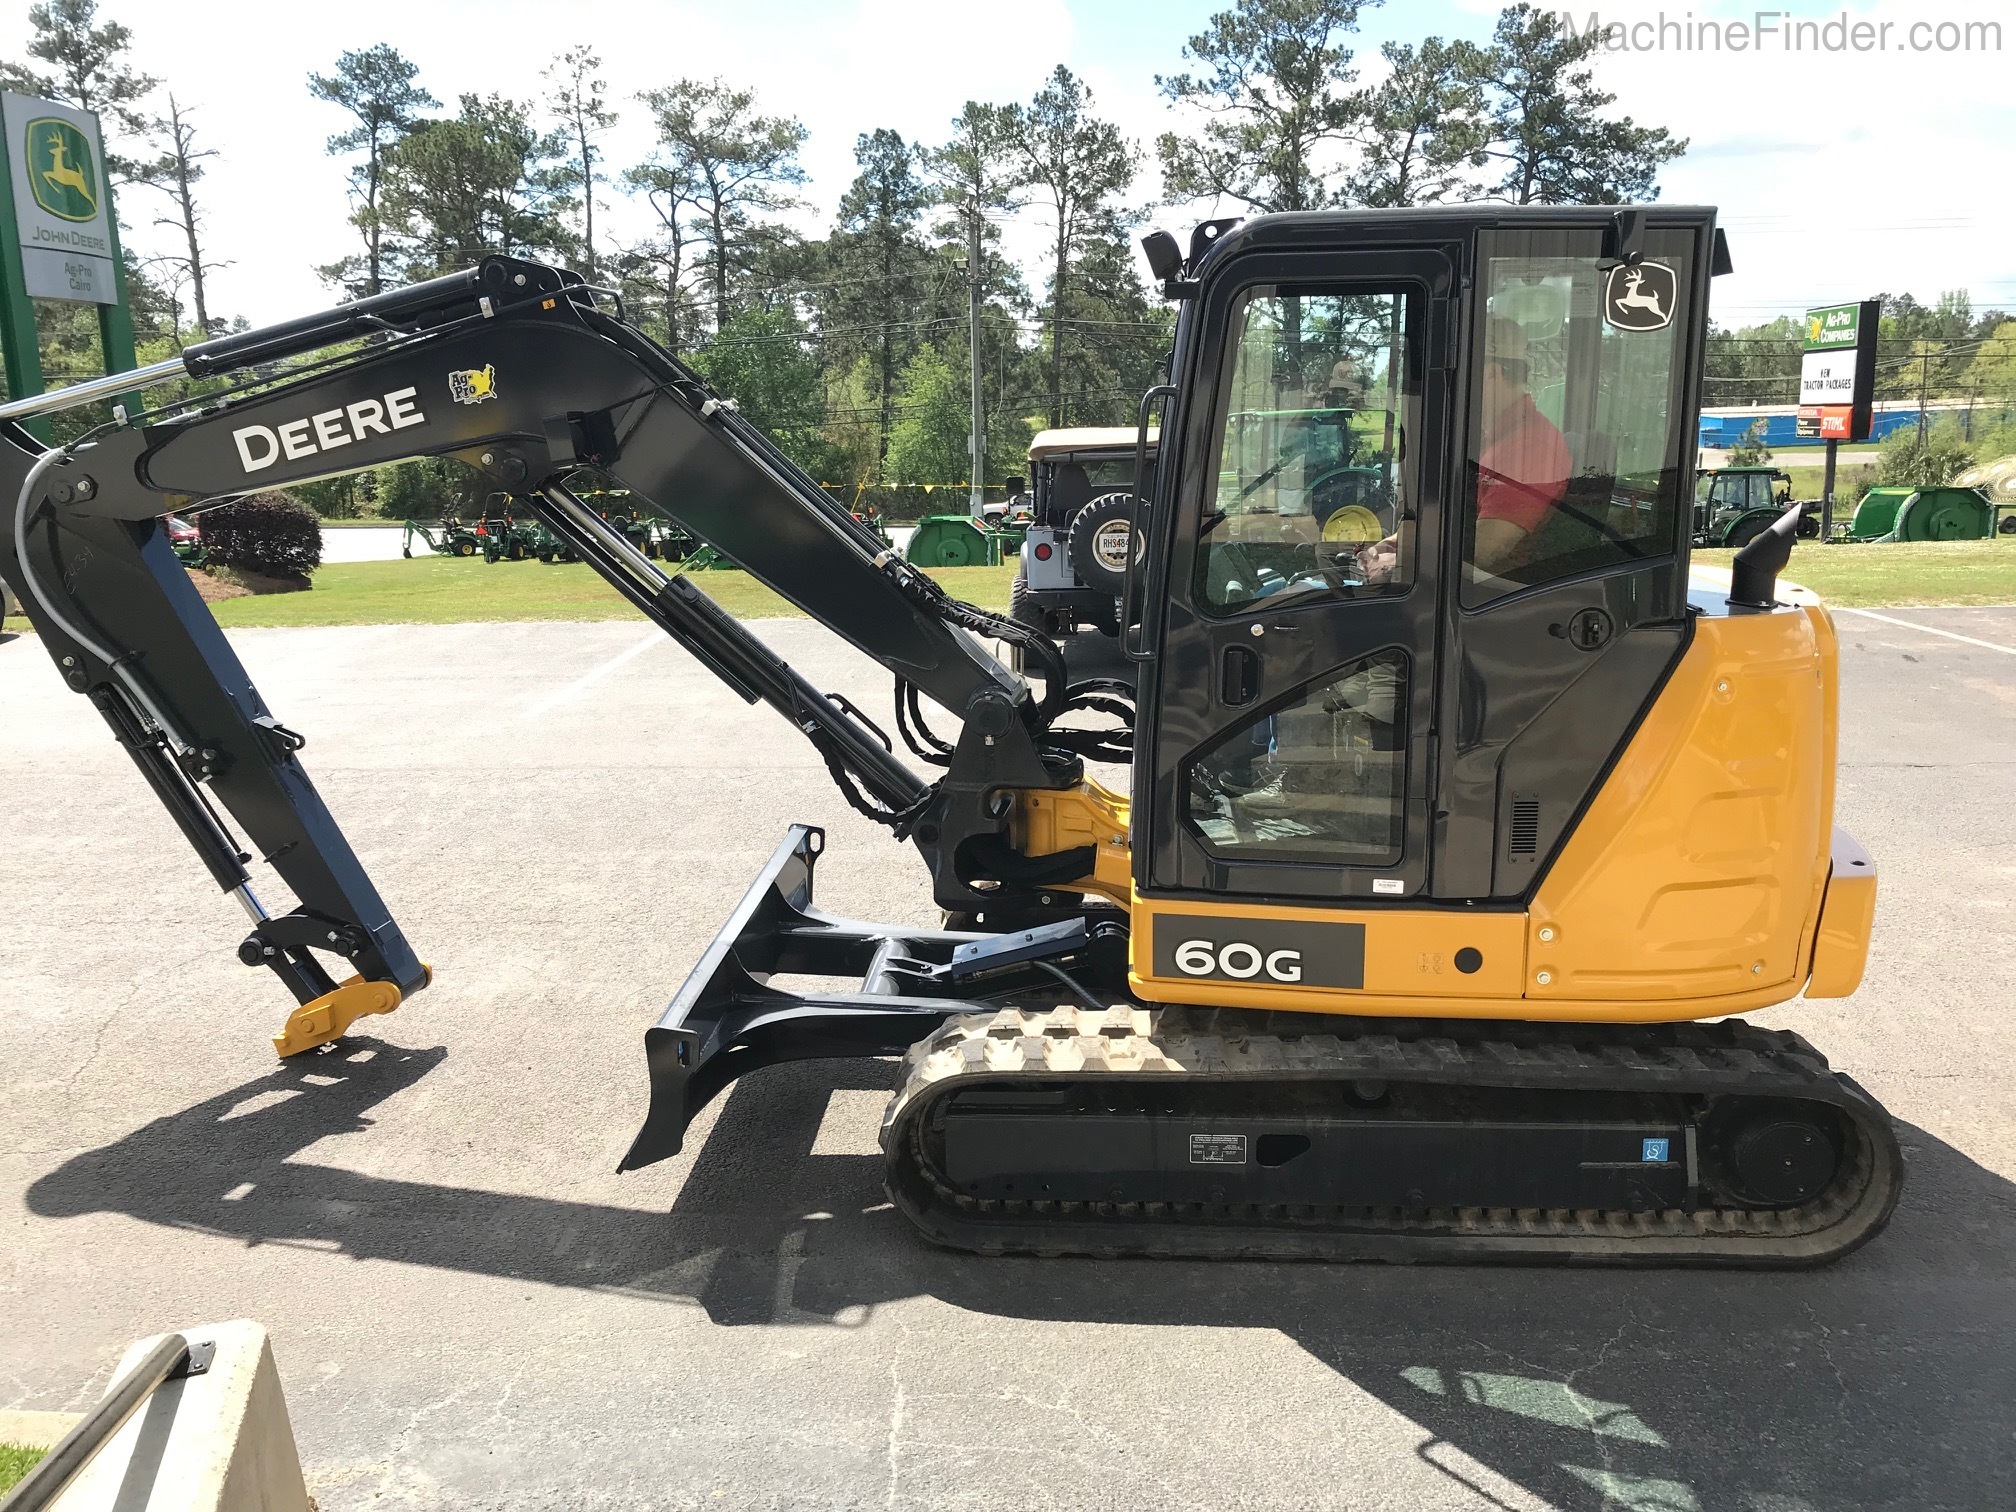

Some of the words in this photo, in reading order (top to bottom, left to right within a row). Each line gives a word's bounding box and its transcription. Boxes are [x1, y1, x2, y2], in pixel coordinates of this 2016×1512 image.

[32, 226, 70, 244] JOHN
[71, 231, 105, 251] DEERE
[64, 262, 92, 277] Ag-Pro
[69, 278, 91, 291] Cairo
[1820, 368, 1831, 378] NEW
[1804, 380, 1823, 390] TRACTOR
[1826, 378, 1851, 390] PACKAGES
[454, 386, 476, 399] Pro
[232, 386, 425, 473] DEERE
[1822, 416, 1845, 431] STIHL
[1174, 939, 1301, 982] 60G
